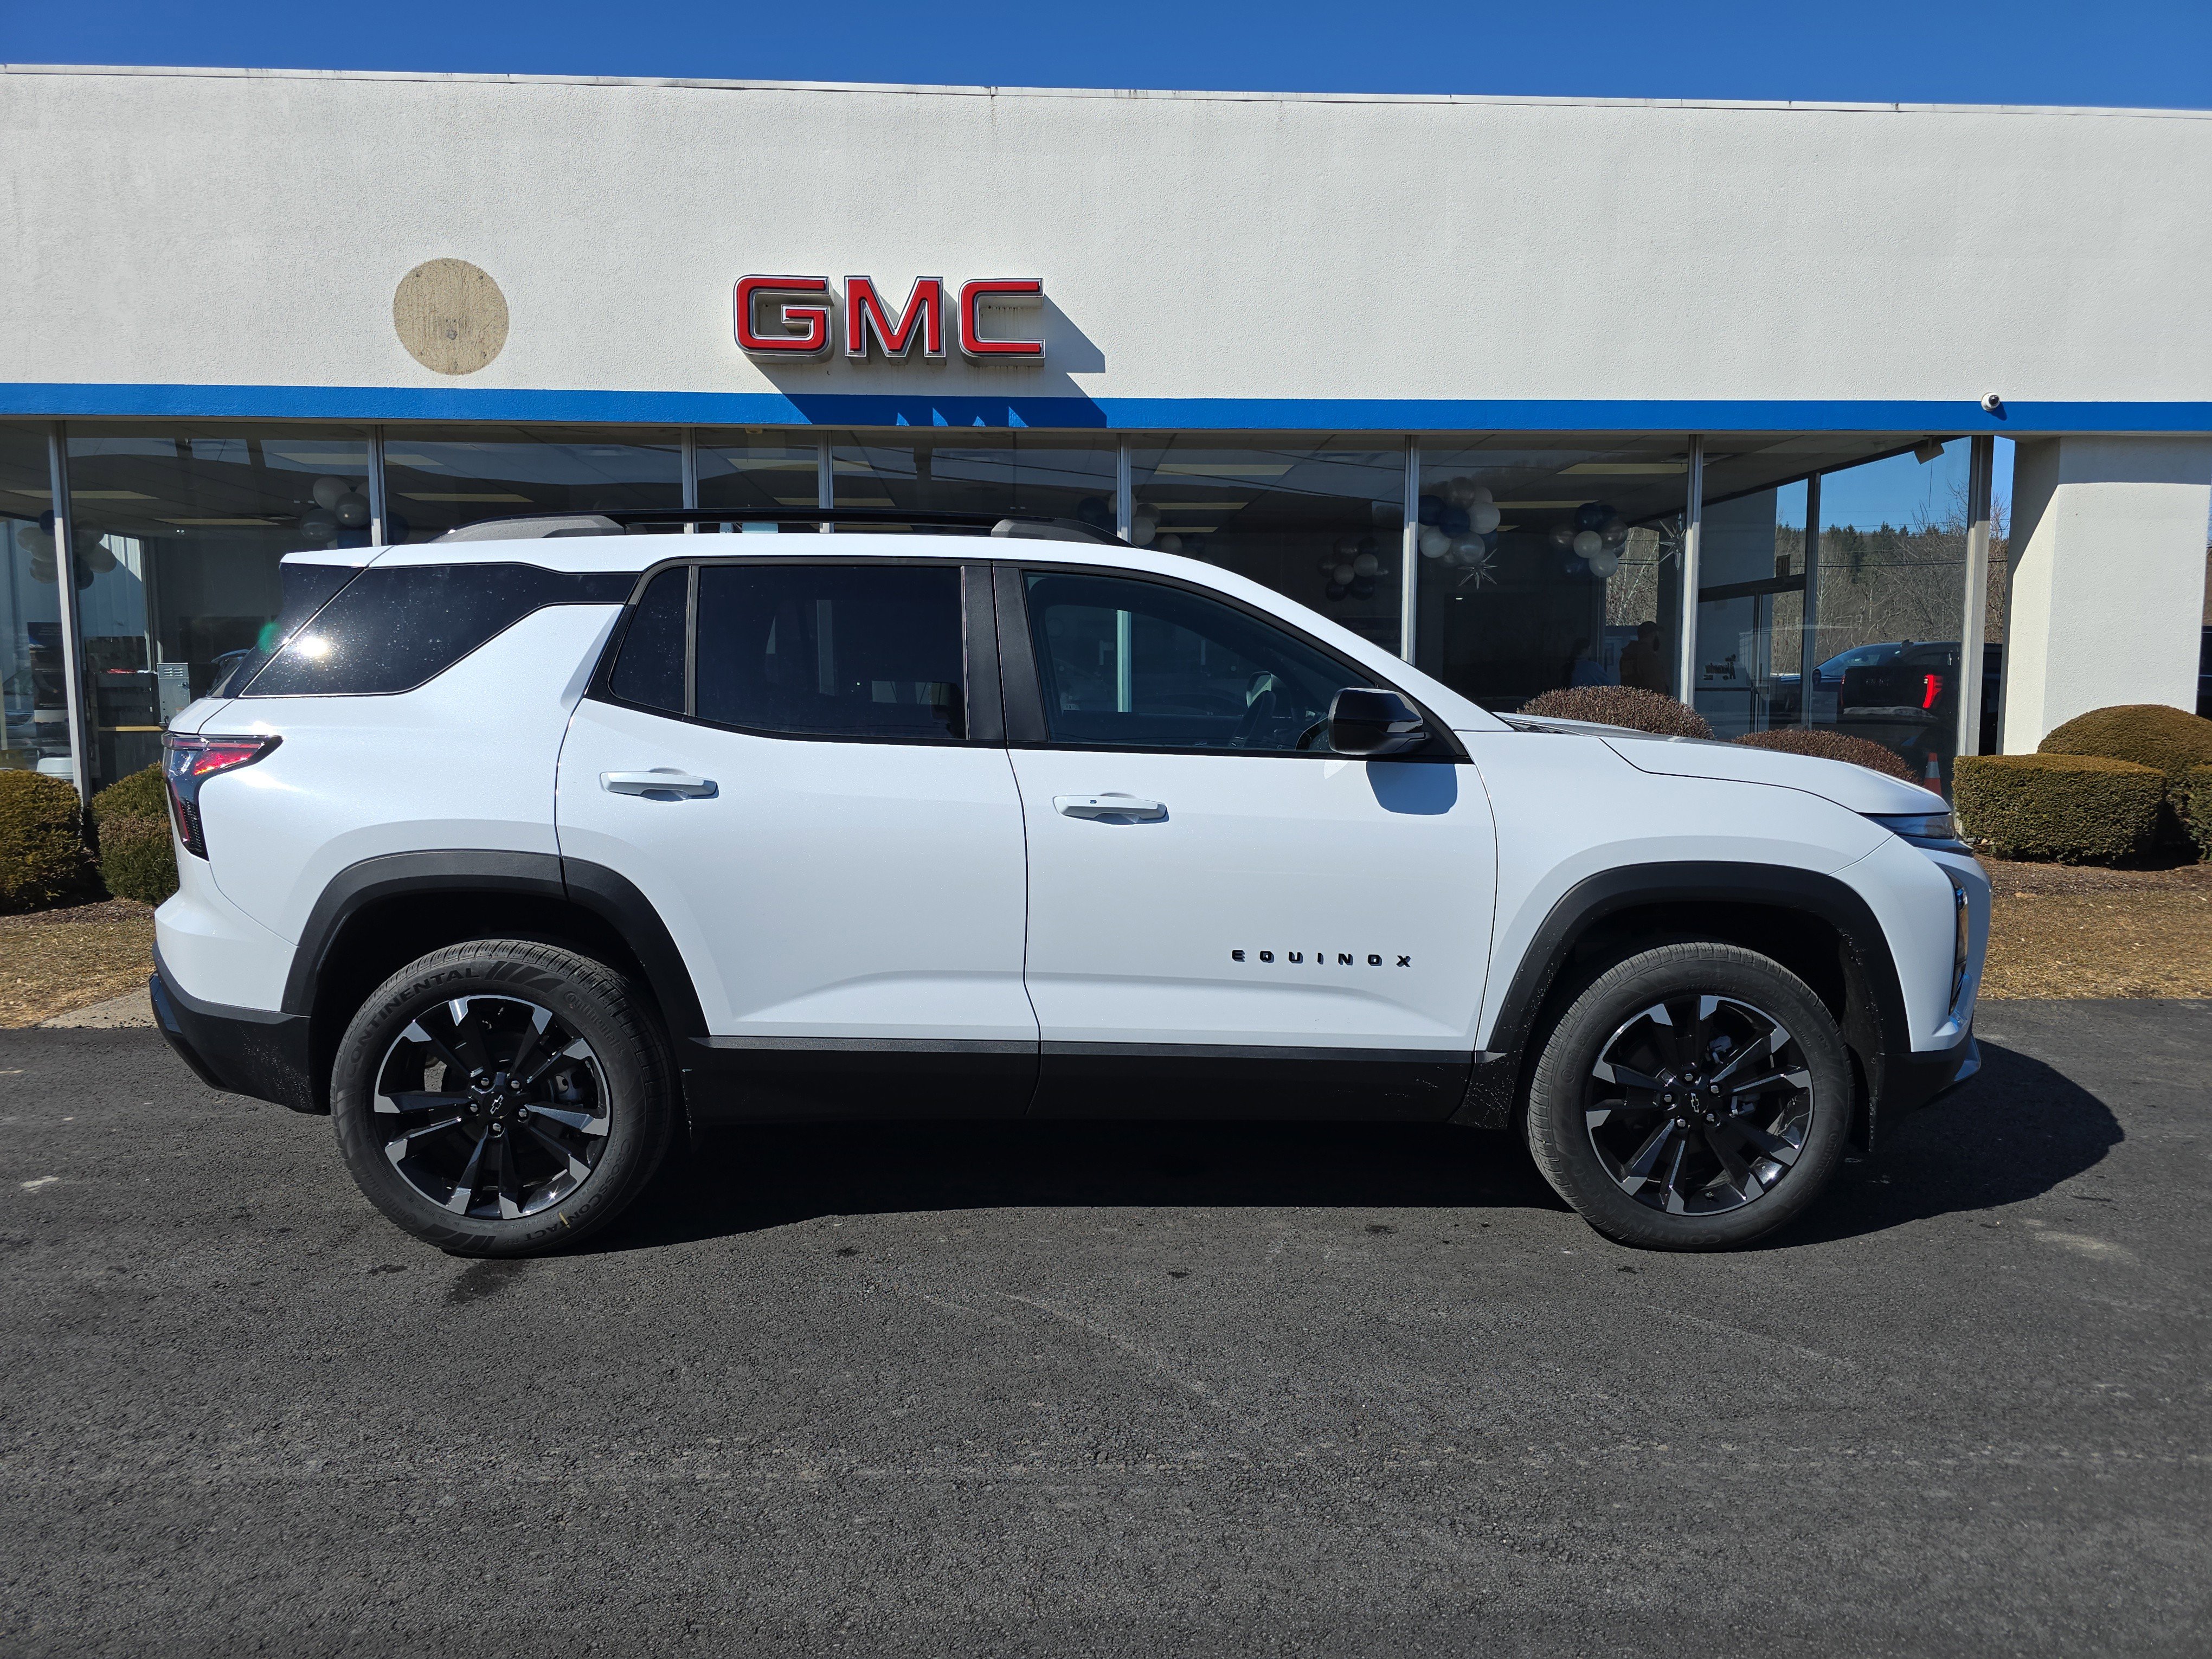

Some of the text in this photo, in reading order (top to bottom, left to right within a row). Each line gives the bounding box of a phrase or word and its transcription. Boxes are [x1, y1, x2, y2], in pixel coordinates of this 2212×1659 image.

[733, 274, 1045, 358] GMC
[1232, 949, 1411, 968] EQUINOX
[346, 968, 480, 1081] CONTINENTAL
